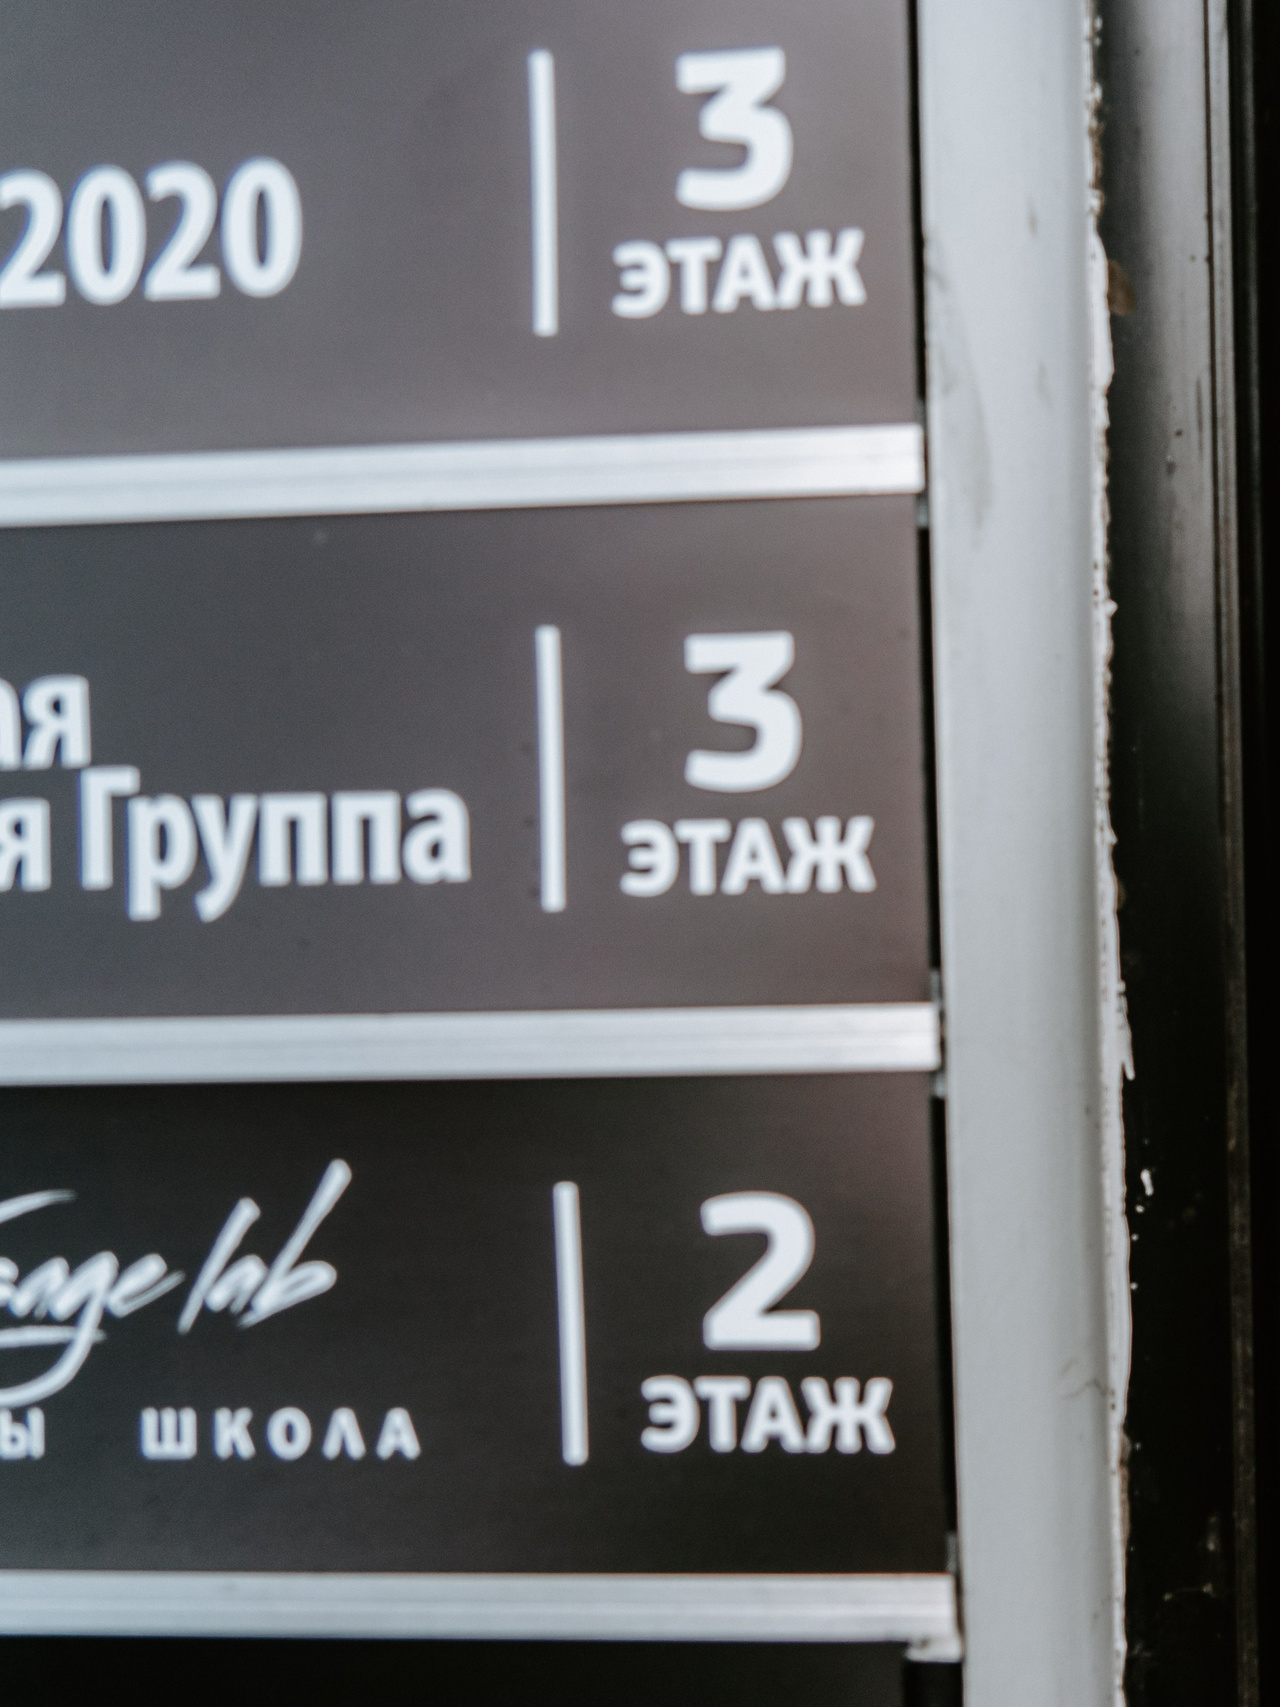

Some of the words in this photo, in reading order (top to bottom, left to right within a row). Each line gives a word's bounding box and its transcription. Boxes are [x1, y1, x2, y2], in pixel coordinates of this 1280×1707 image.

[675, 46, 794, 211] 3
[0, 157, 304, 308] 2020
[611, 228, 868, 319] ЭТАЖ
[684, 630, 803, 793] 3
[78, 764, 471, 922] Группа
[619, 815, 877, 897] ЭТАЖ
[699, 1190, 822, 1351] 2
[140, 1405, 422, 1461] ШКОЛА
[640, 1374, 897, 1455] ЭТАЖ
